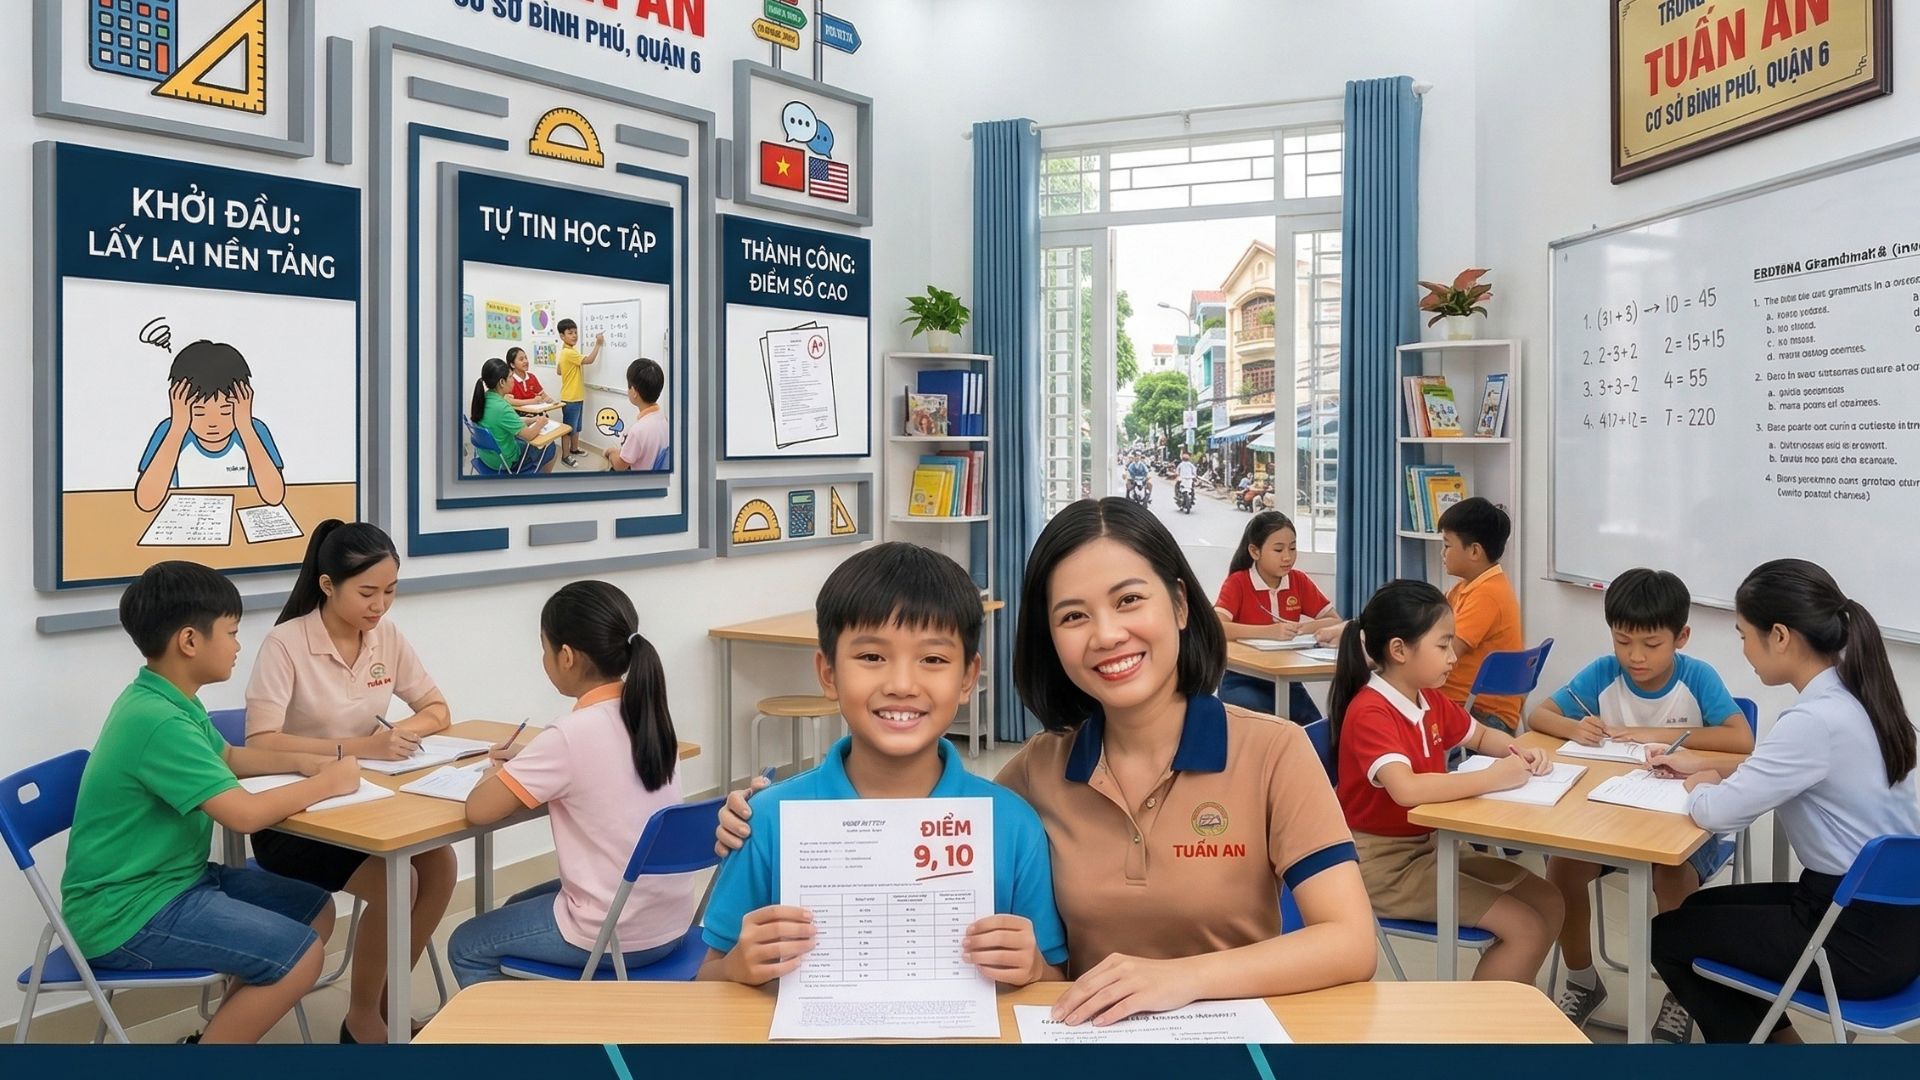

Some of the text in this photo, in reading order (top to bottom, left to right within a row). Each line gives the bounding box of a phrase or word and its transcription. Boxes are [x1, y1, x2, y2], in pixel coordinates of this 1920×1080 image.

[1658, 0, 1704, 26] TRUN
[529, 1, 579, 39] BÌNH
[586, 19, 631, 57] PHÚ,
[636, 35, 685, 70] QUẬN
[691, 51, 701, 74] 6
[1644, 0, 1829, 96] TUẤN AN
[1645, 41, 1830, 133] CƠ SỞ BÌNH PHÚ, QUẬN 6
[132, 183, 300, 235] KHỞI ĐẦU:
[479, 205, 657, 258] TỰ TIN HỌC TẬP
[88, 223, 335, 279] LẤY LẠI NỀN TẢNG
[741, 236, 855, 274] THÀNH CÔNG:
[749, 266, 848, 301] ĐIỂM SỐ CAO
[1583, 313, 1592, 330] 1.
[1665, 294, 1679, 313] 10
[1698, 287, 1717, 307] 45
[1583, 350, 1593, 365] 2.
[1583, 380, 1593, 397] 3.
[1664, 371, 1673, 388] 4
[1689, 368, 1708, 387] 55
[1689, 407, 1716, 426] 220
[920, 812, 972, 837] ĐIỂM
[913, 844, 974, 871] 9, 10
[1173, 838, 1245, 858] TUẤN AN
